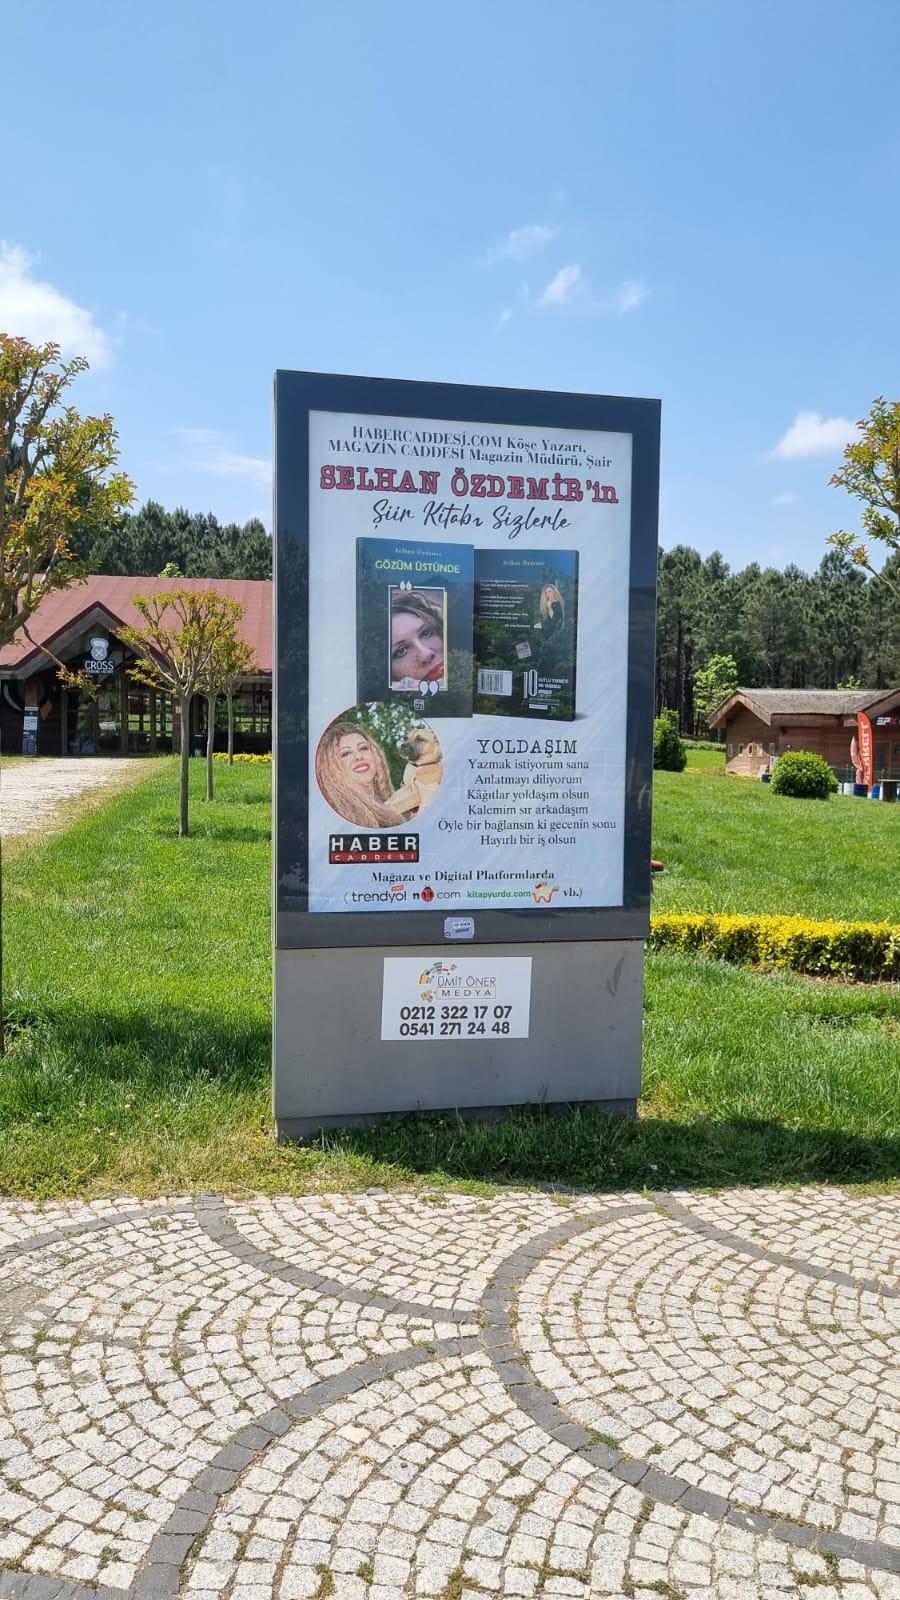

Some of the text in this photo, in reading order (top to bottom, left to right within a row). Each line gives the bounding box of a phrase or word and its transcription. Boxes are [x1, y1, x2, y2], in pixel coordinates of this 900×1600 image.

[352, 426, 502, 449] HABERCADDESİ.COM
[506, 437, 538, 453] Köşe
[328, 439, 397, 455] MAGAZİN
[400, 444, 465, 460] CADDESİ
[469, 449, 523, 466] Magazin
[586, 455, 613, 470] Şair
[320, 464, 440, 495] SELHAN
[372, 498, 571, 540] Şiir Kitabı Sizlerle
[374, 558, 461, 574] GÖZÜM ÜSTÜNDE
[84, 660, 114, 670] CROSS
[477, 739, 578, 758] YOLDAŞIM
[468, 758, 590, 773] Yazmak istiyorum sana
[474, 774, 582, 787] Anlatmayı diliyorum
[512, 788, 559, 803] yoldaşım
[562, 789, 590, 801] olsun
[468, 804, 589, 816] Kalemim sır arkadaşım
[438, 817, 617, 833] Öyle bir bağlansın ki gecenin sonu
[331, 836, 418, 852] HABER
[480, 833, 577, 848] Hayırlı bir iş olsun
[372, 869, 555, 885] Mağaza ve Digital Platformlarda
[466, 889, 532, 903] kitapyurdu.com
[562, 887, 583, 900] vb.)
[436, 975, 497, 988] ÜMİT ÖNER
[441, 988, 492, 998] MEDYA
[400, 1005, 513, 1021] 0212 322 17 07
[399, 1020, 511, 1037] 0541 271 24 48
